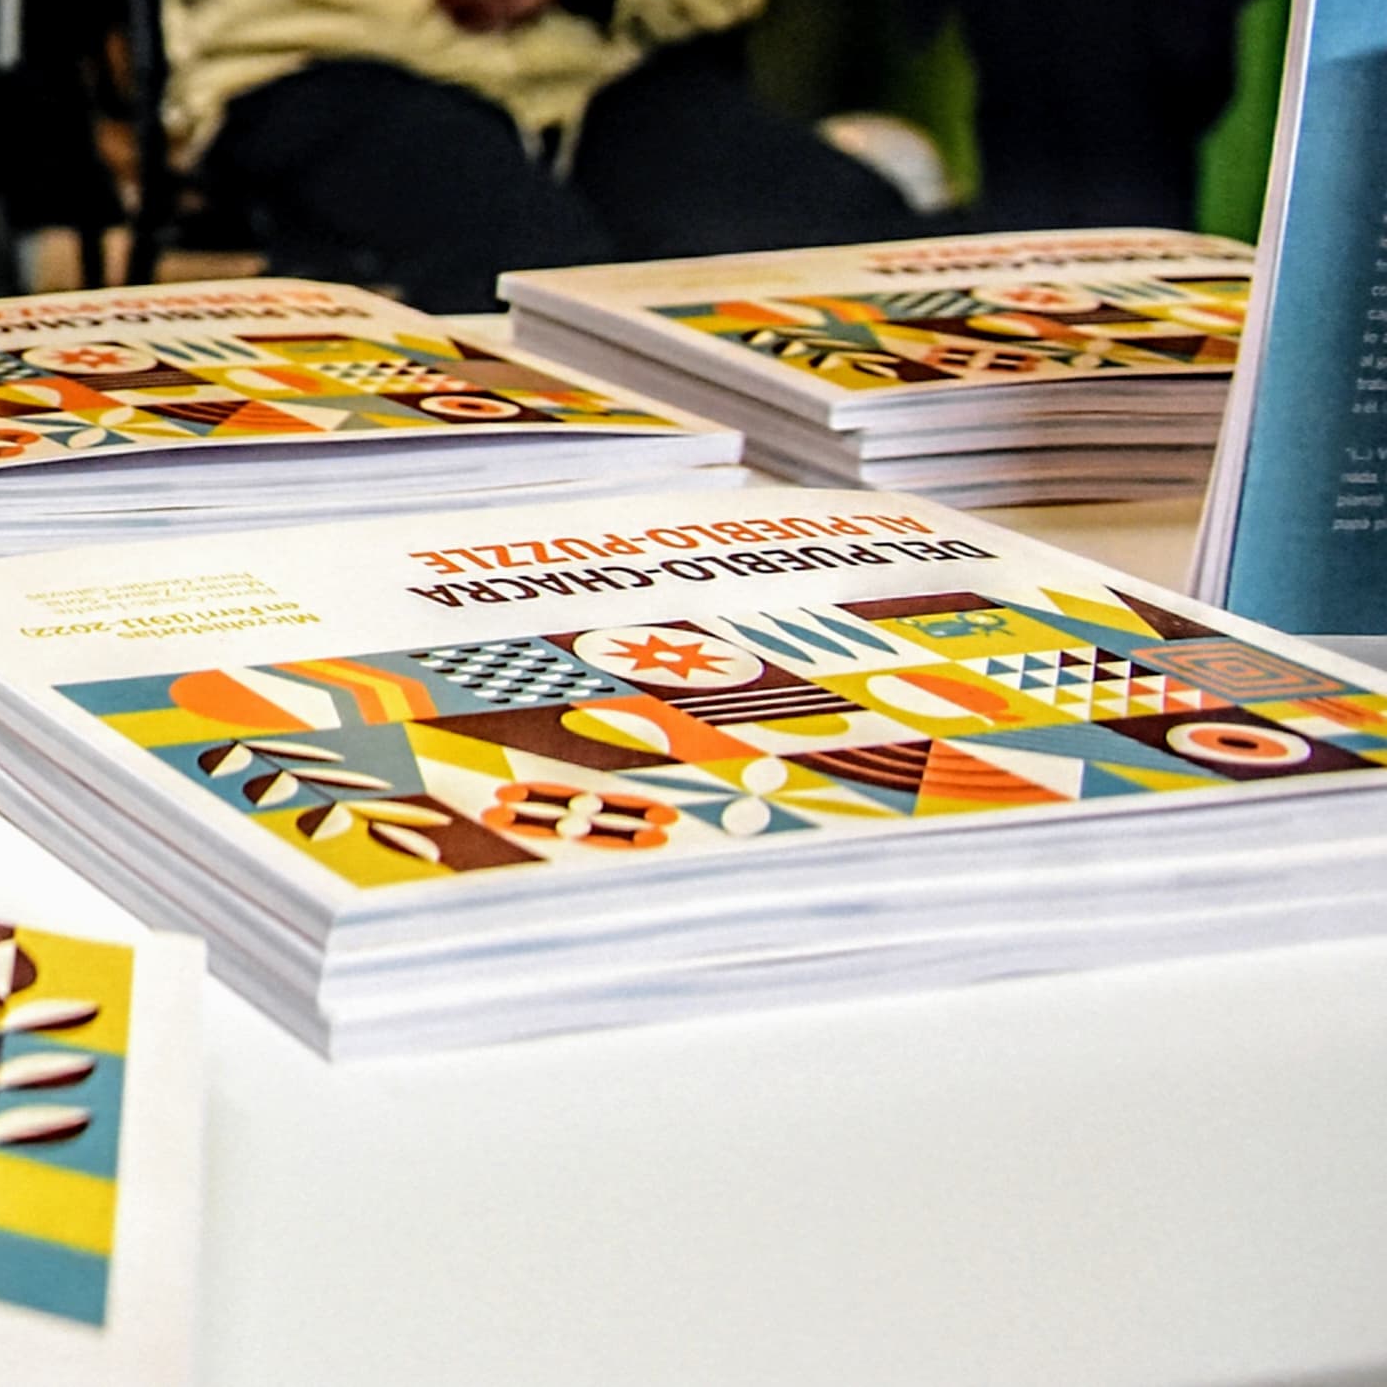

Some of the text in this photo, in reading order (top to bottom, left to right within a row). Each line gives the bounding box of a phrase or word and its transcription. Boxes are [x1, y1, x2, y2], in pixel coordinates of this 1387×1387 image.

[408, 514, 935, 575] AL PUEBLO-PUZZLE
[407, 540, 998, 608] DEL PUEBLO-CHACRA
[19, 609, 192, 640] (1911-2022)
[116, 613, 321, 640] Microhistorias
